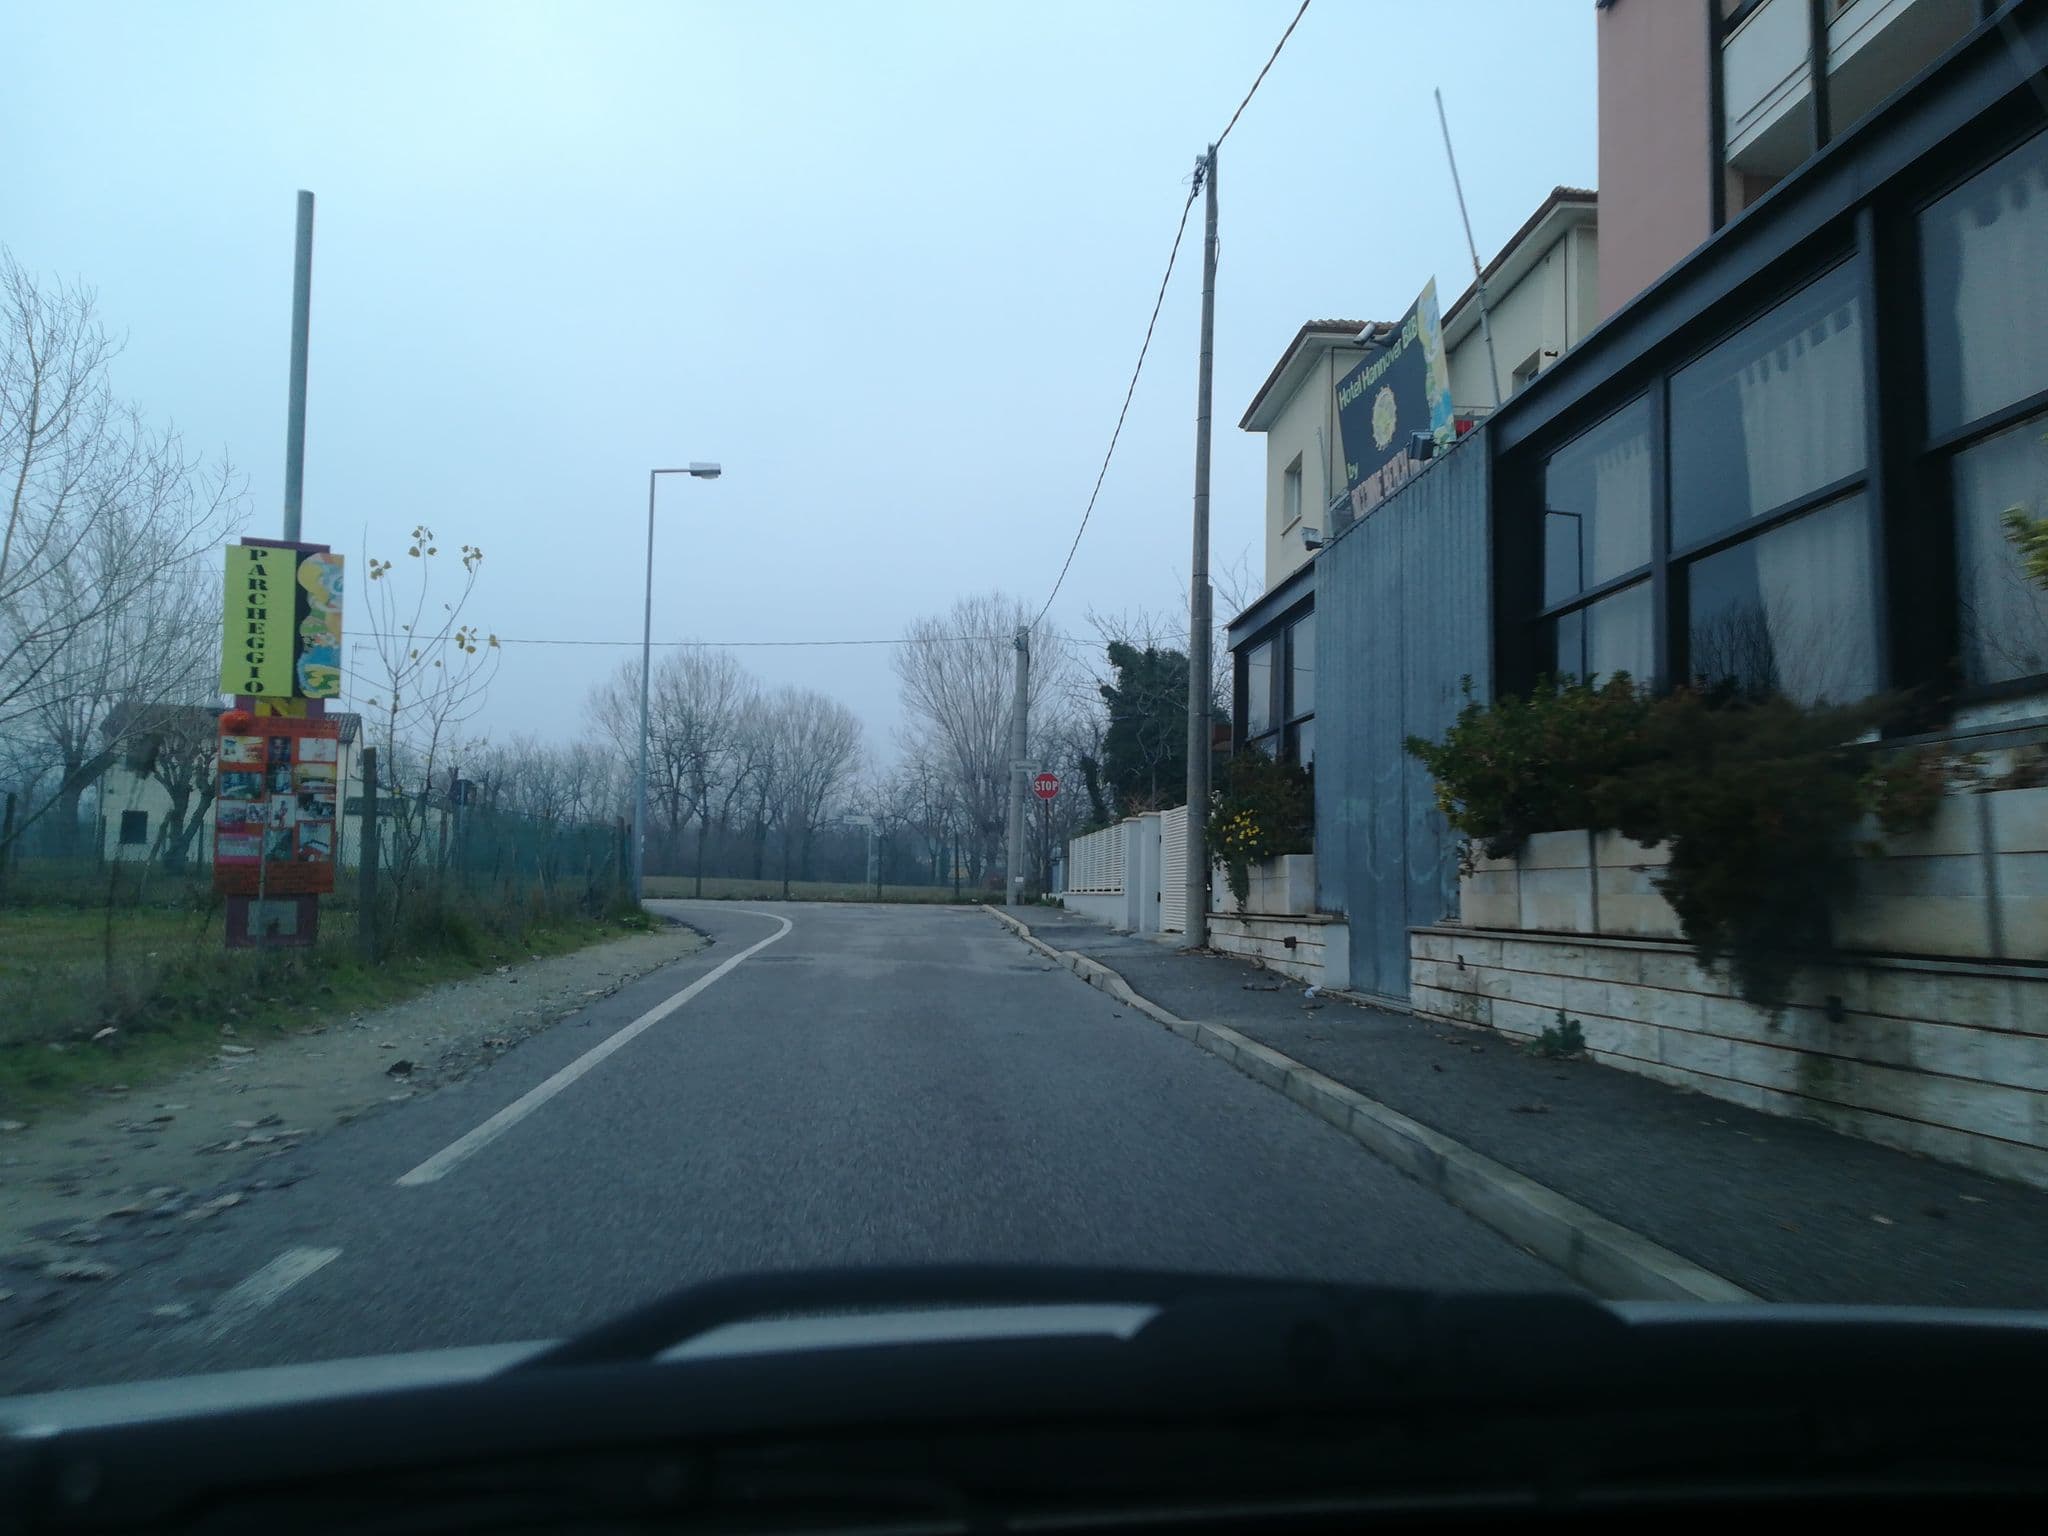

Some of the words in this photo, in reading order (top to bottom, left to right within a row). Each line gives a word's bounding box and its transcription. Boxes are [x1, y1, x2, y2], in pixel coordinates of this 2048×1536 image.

[1338, 374, 1363, 411] Hotel
[1361, 338, 1402, 392] Hannover
[1347, 462, 1359, 480] by
[244, 549, 268, 693] PARCHEGGIO
[1034, 780, 1058, 791] STOP
